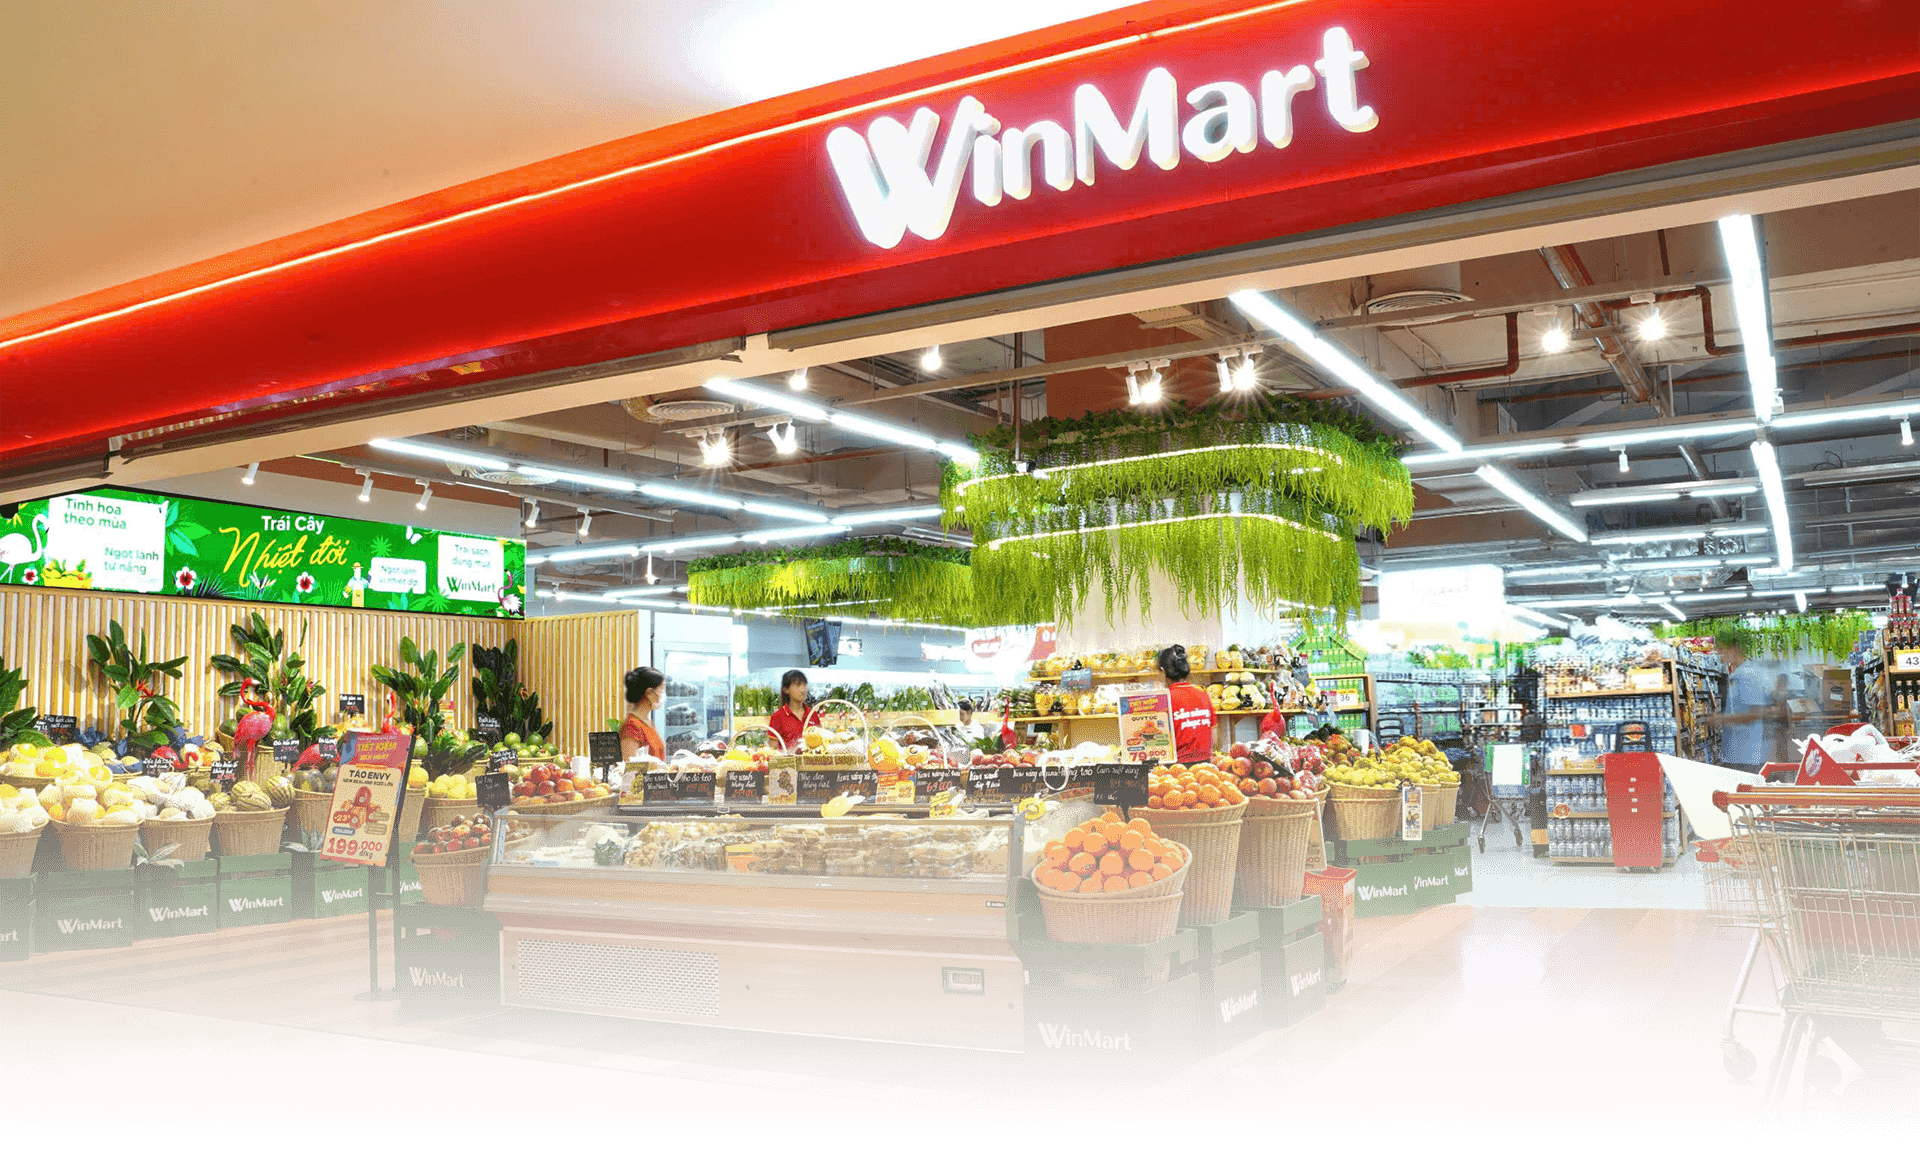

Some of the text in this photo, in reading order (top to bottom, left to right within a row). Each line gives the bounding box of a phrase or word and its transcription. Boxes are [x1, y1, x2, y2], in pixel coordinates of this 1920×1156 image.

[825, 25, 1379, 249] WinMart
[97, 502, 122, 515] hoa
[64, 512, 95, 526] theo
[261, 515, 325, 535] Trái Cây
[219, 527, 309, 588] Nhiệt
[445, 575, 497, 593] WinMart
[1905, 656, 1920, 666] 43
[1340, 694, 1351, 702] 36
[367, 771, 391, 781] ENVY
[321, 887, 363, 904] WinMart
[1357, 884, 1408, 901] WinMart
[228, 896, 284, 912] WinMart
[149, 905, 209, 922] WinMart
[56, 917, 123, 934] WinMart
[409, 966, 465, 988] WinMart
[1291, 967, 1322, 997] WinMart
[1220, 989, 1258, 1024] WinMart
[1037, 1022, 1133, 1051] WinMart
